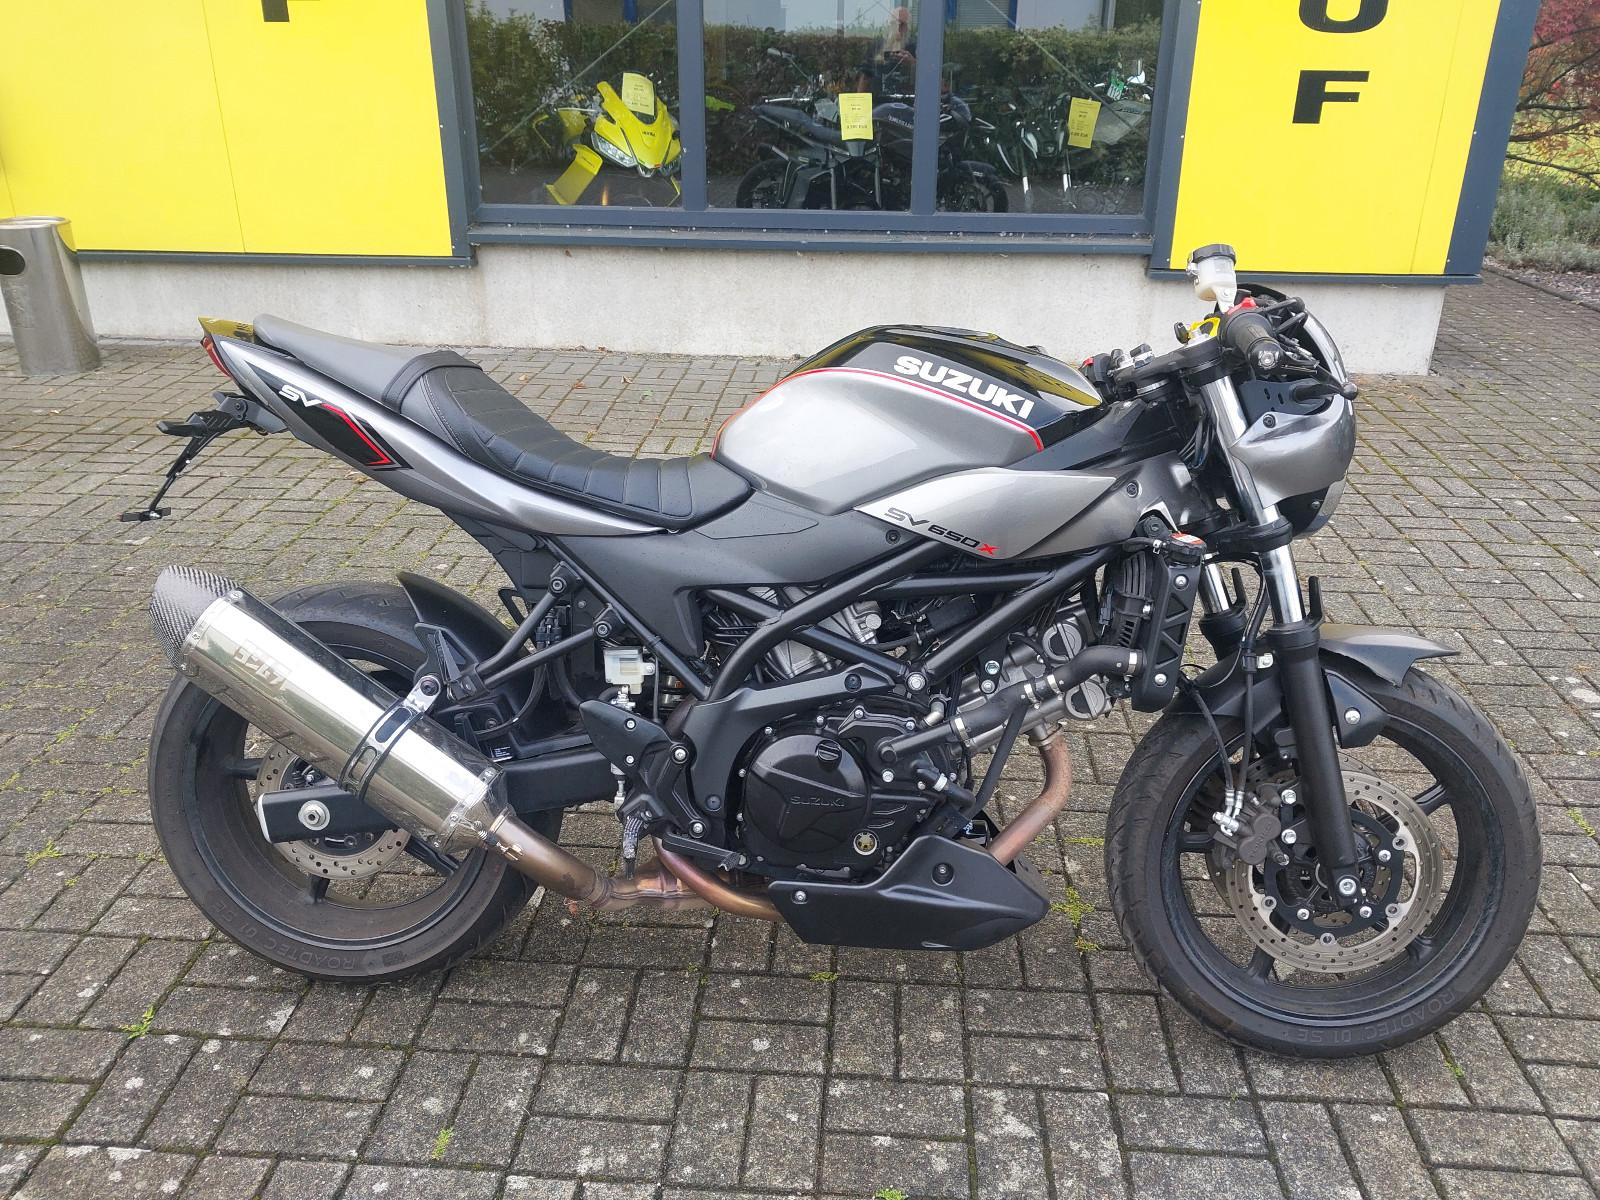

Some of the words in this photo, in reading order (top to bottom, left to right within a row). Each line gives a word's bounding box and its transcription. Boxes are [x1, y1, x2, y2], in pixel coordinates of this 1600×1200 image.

[278, 384, 322, 408] SV
[893, 355, 1035, 420] SUZUKI
[263, 938, 356, 970] ROADTEC
[1363, 991, 1457, 1040] ROADTEC
[1299, 1029, 1323, 1043] SE
